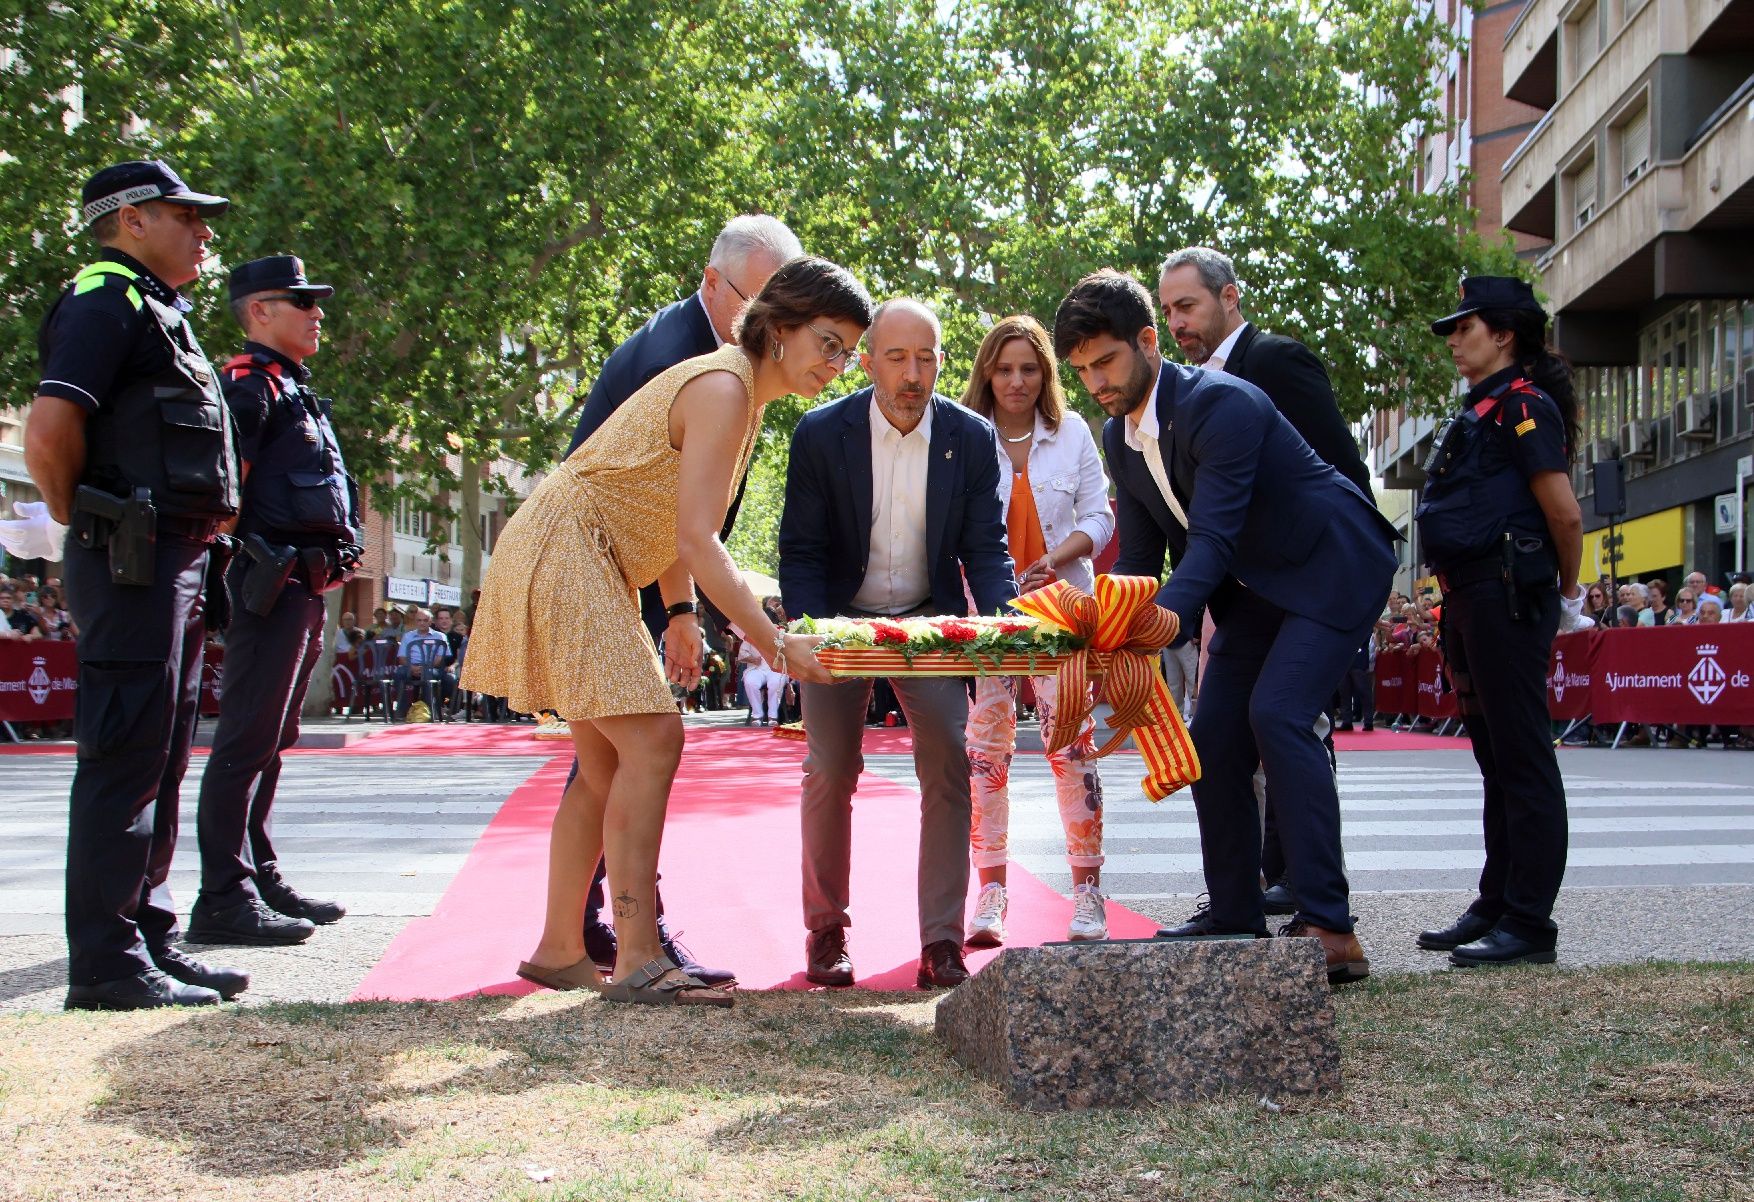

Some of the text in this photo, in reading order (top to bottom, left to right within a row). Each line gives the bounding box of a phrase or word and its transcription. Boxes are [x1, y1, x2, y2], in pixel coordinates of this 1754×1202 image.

[389, 582, 425, 598] CAFETERIA
[51, 676, 63, 690] de
[1604, 669, 1750, 692] Ajuntament de
